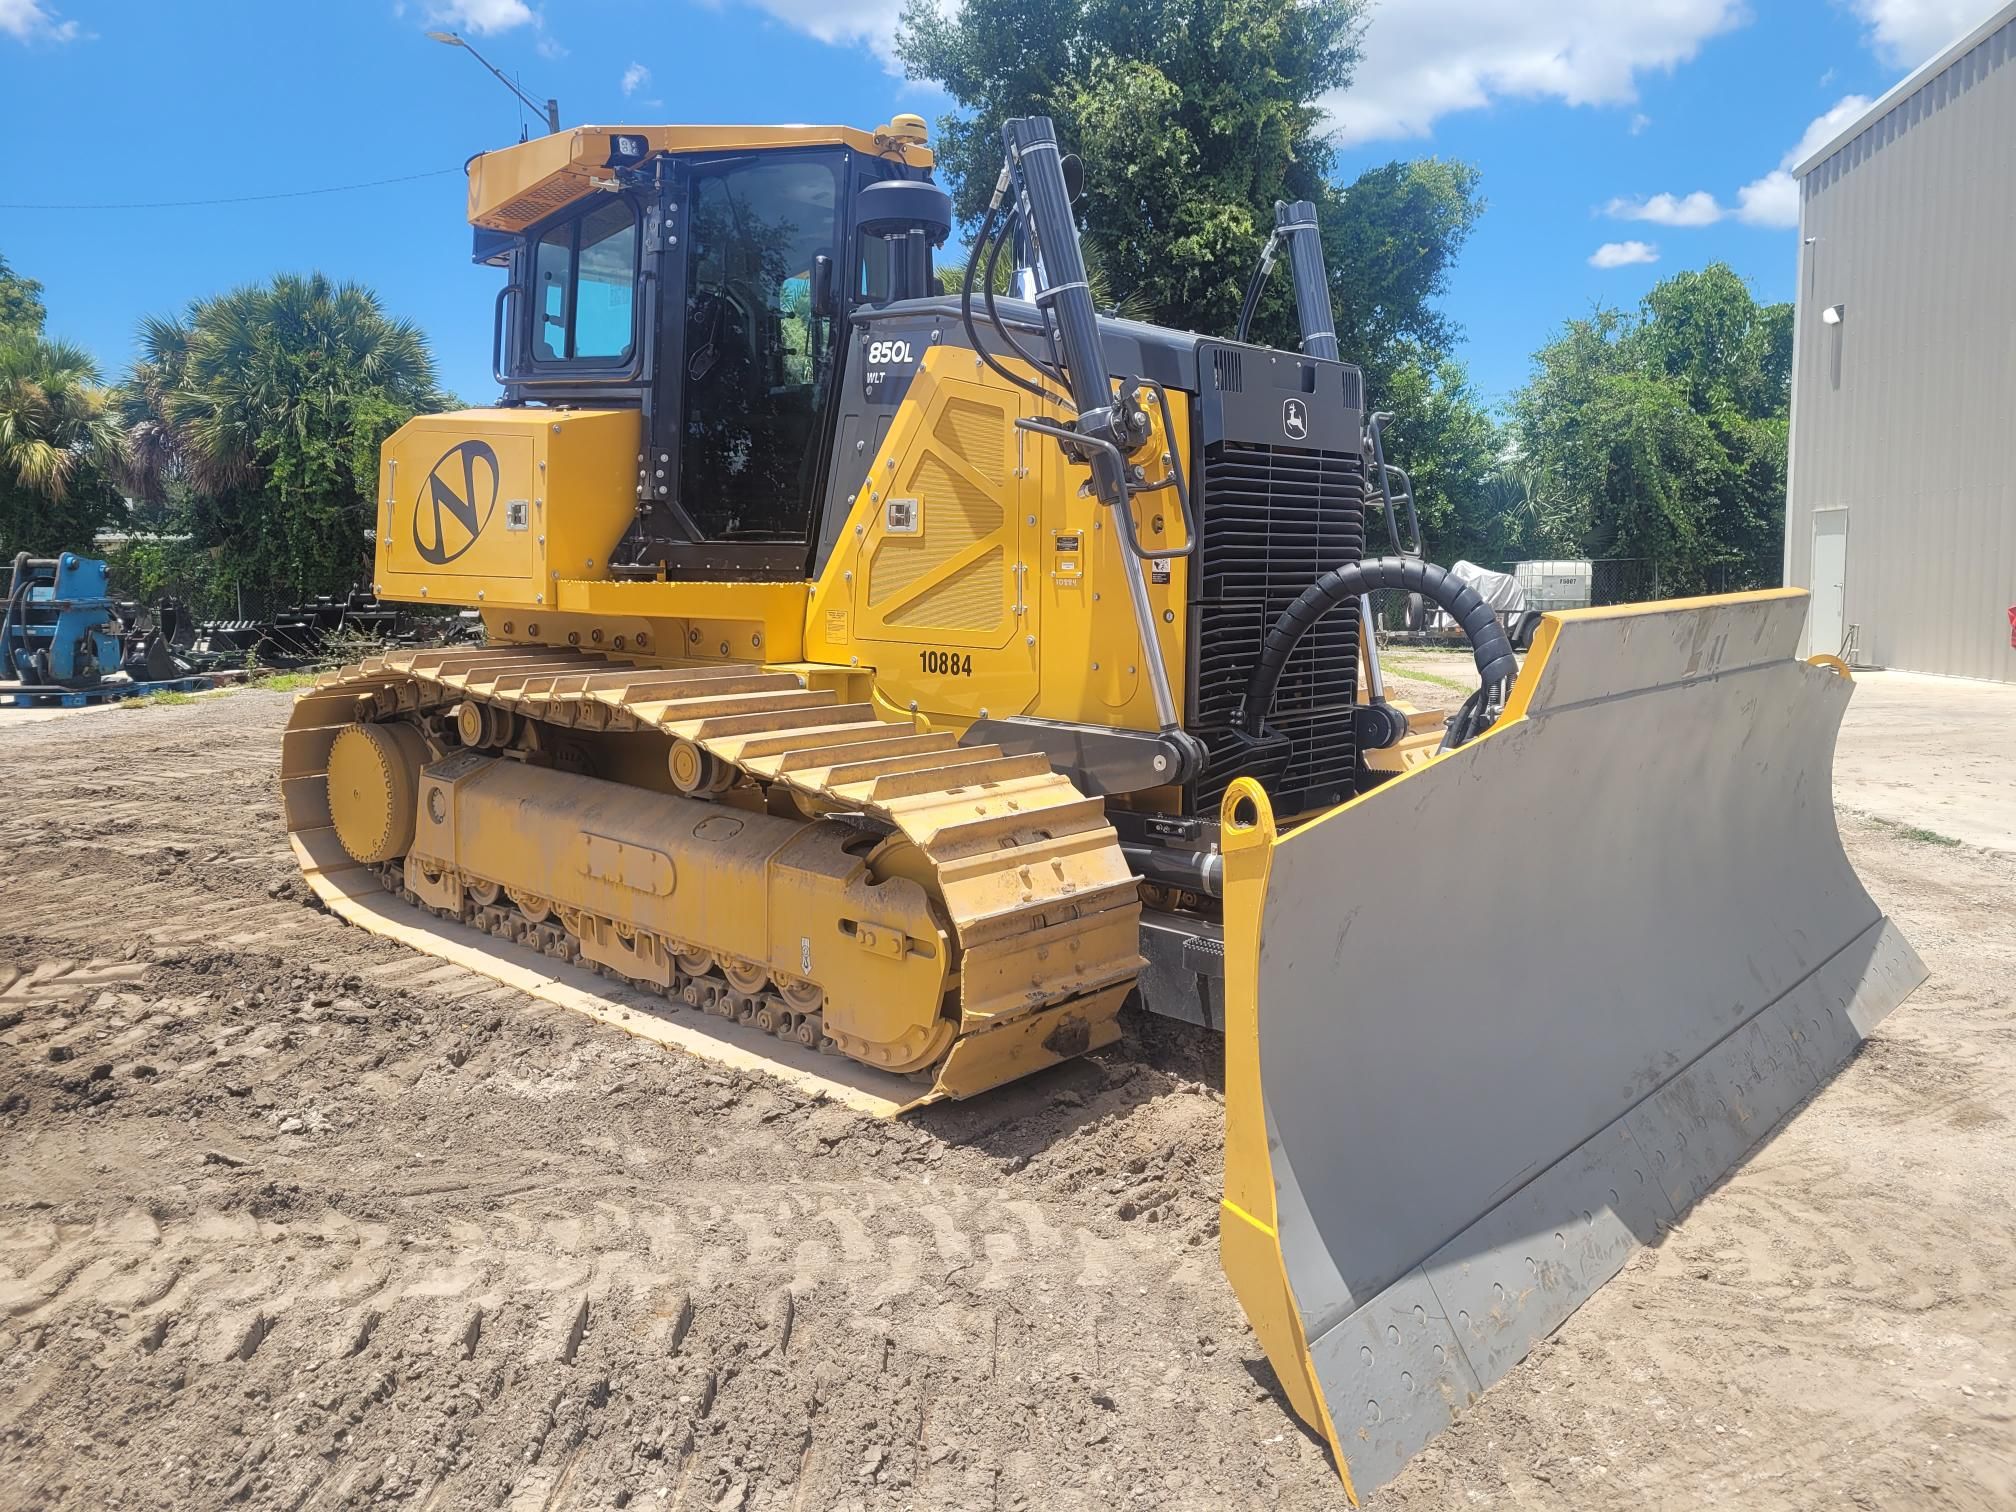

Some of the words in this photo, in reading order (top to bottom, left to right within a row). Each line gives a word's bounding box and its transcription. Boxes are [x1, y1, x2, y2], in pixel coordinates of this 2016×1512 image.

[869, 340, 913, 364] 850L
[867, 372, 886, 384] WLT
[919, 650, 972, 677] 10884
